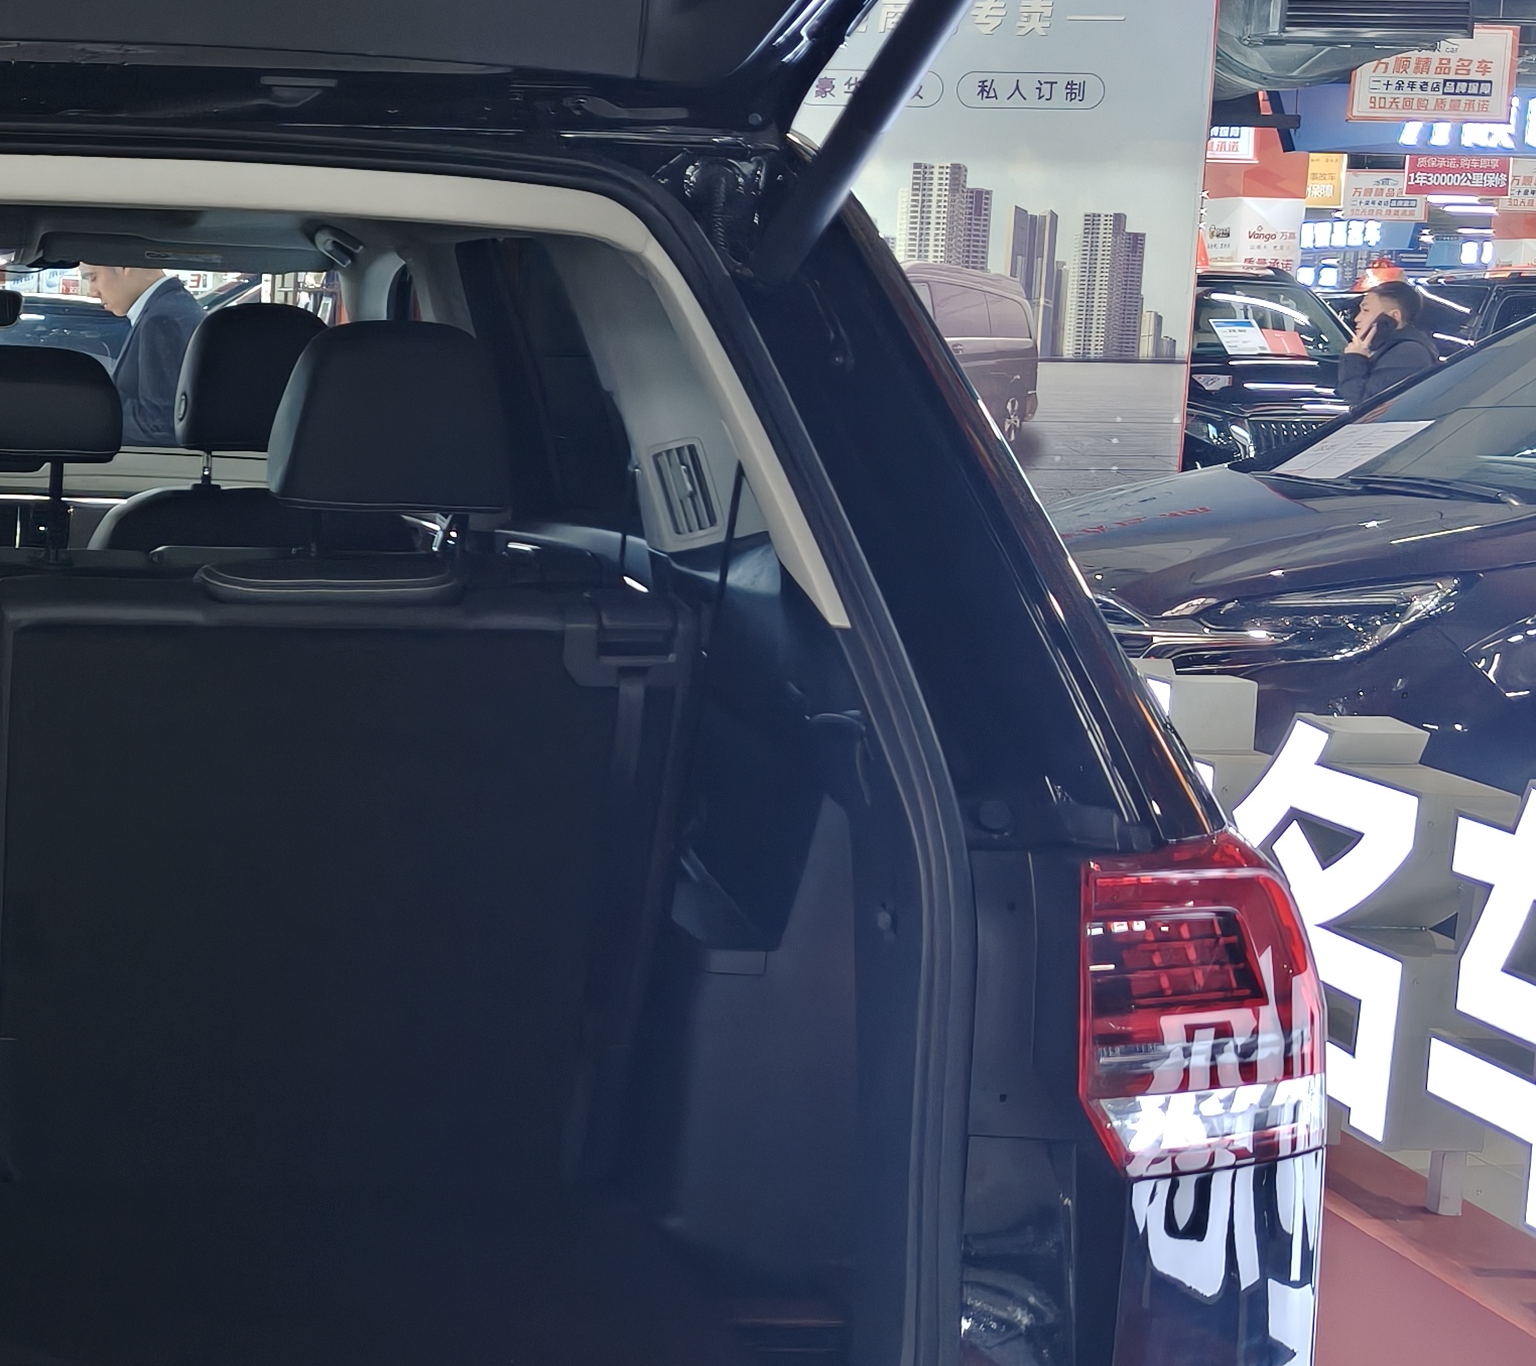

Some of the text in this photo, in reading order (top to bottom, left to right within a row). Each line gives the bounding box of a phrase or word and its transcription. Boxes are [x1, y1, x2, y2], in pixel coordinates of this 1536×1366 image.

[976, 78, 1087, 103] 私人订制
[1407, 171, 1508, 188] 1年30000公里保修
[1248, 230, 1277, 243] Vango
